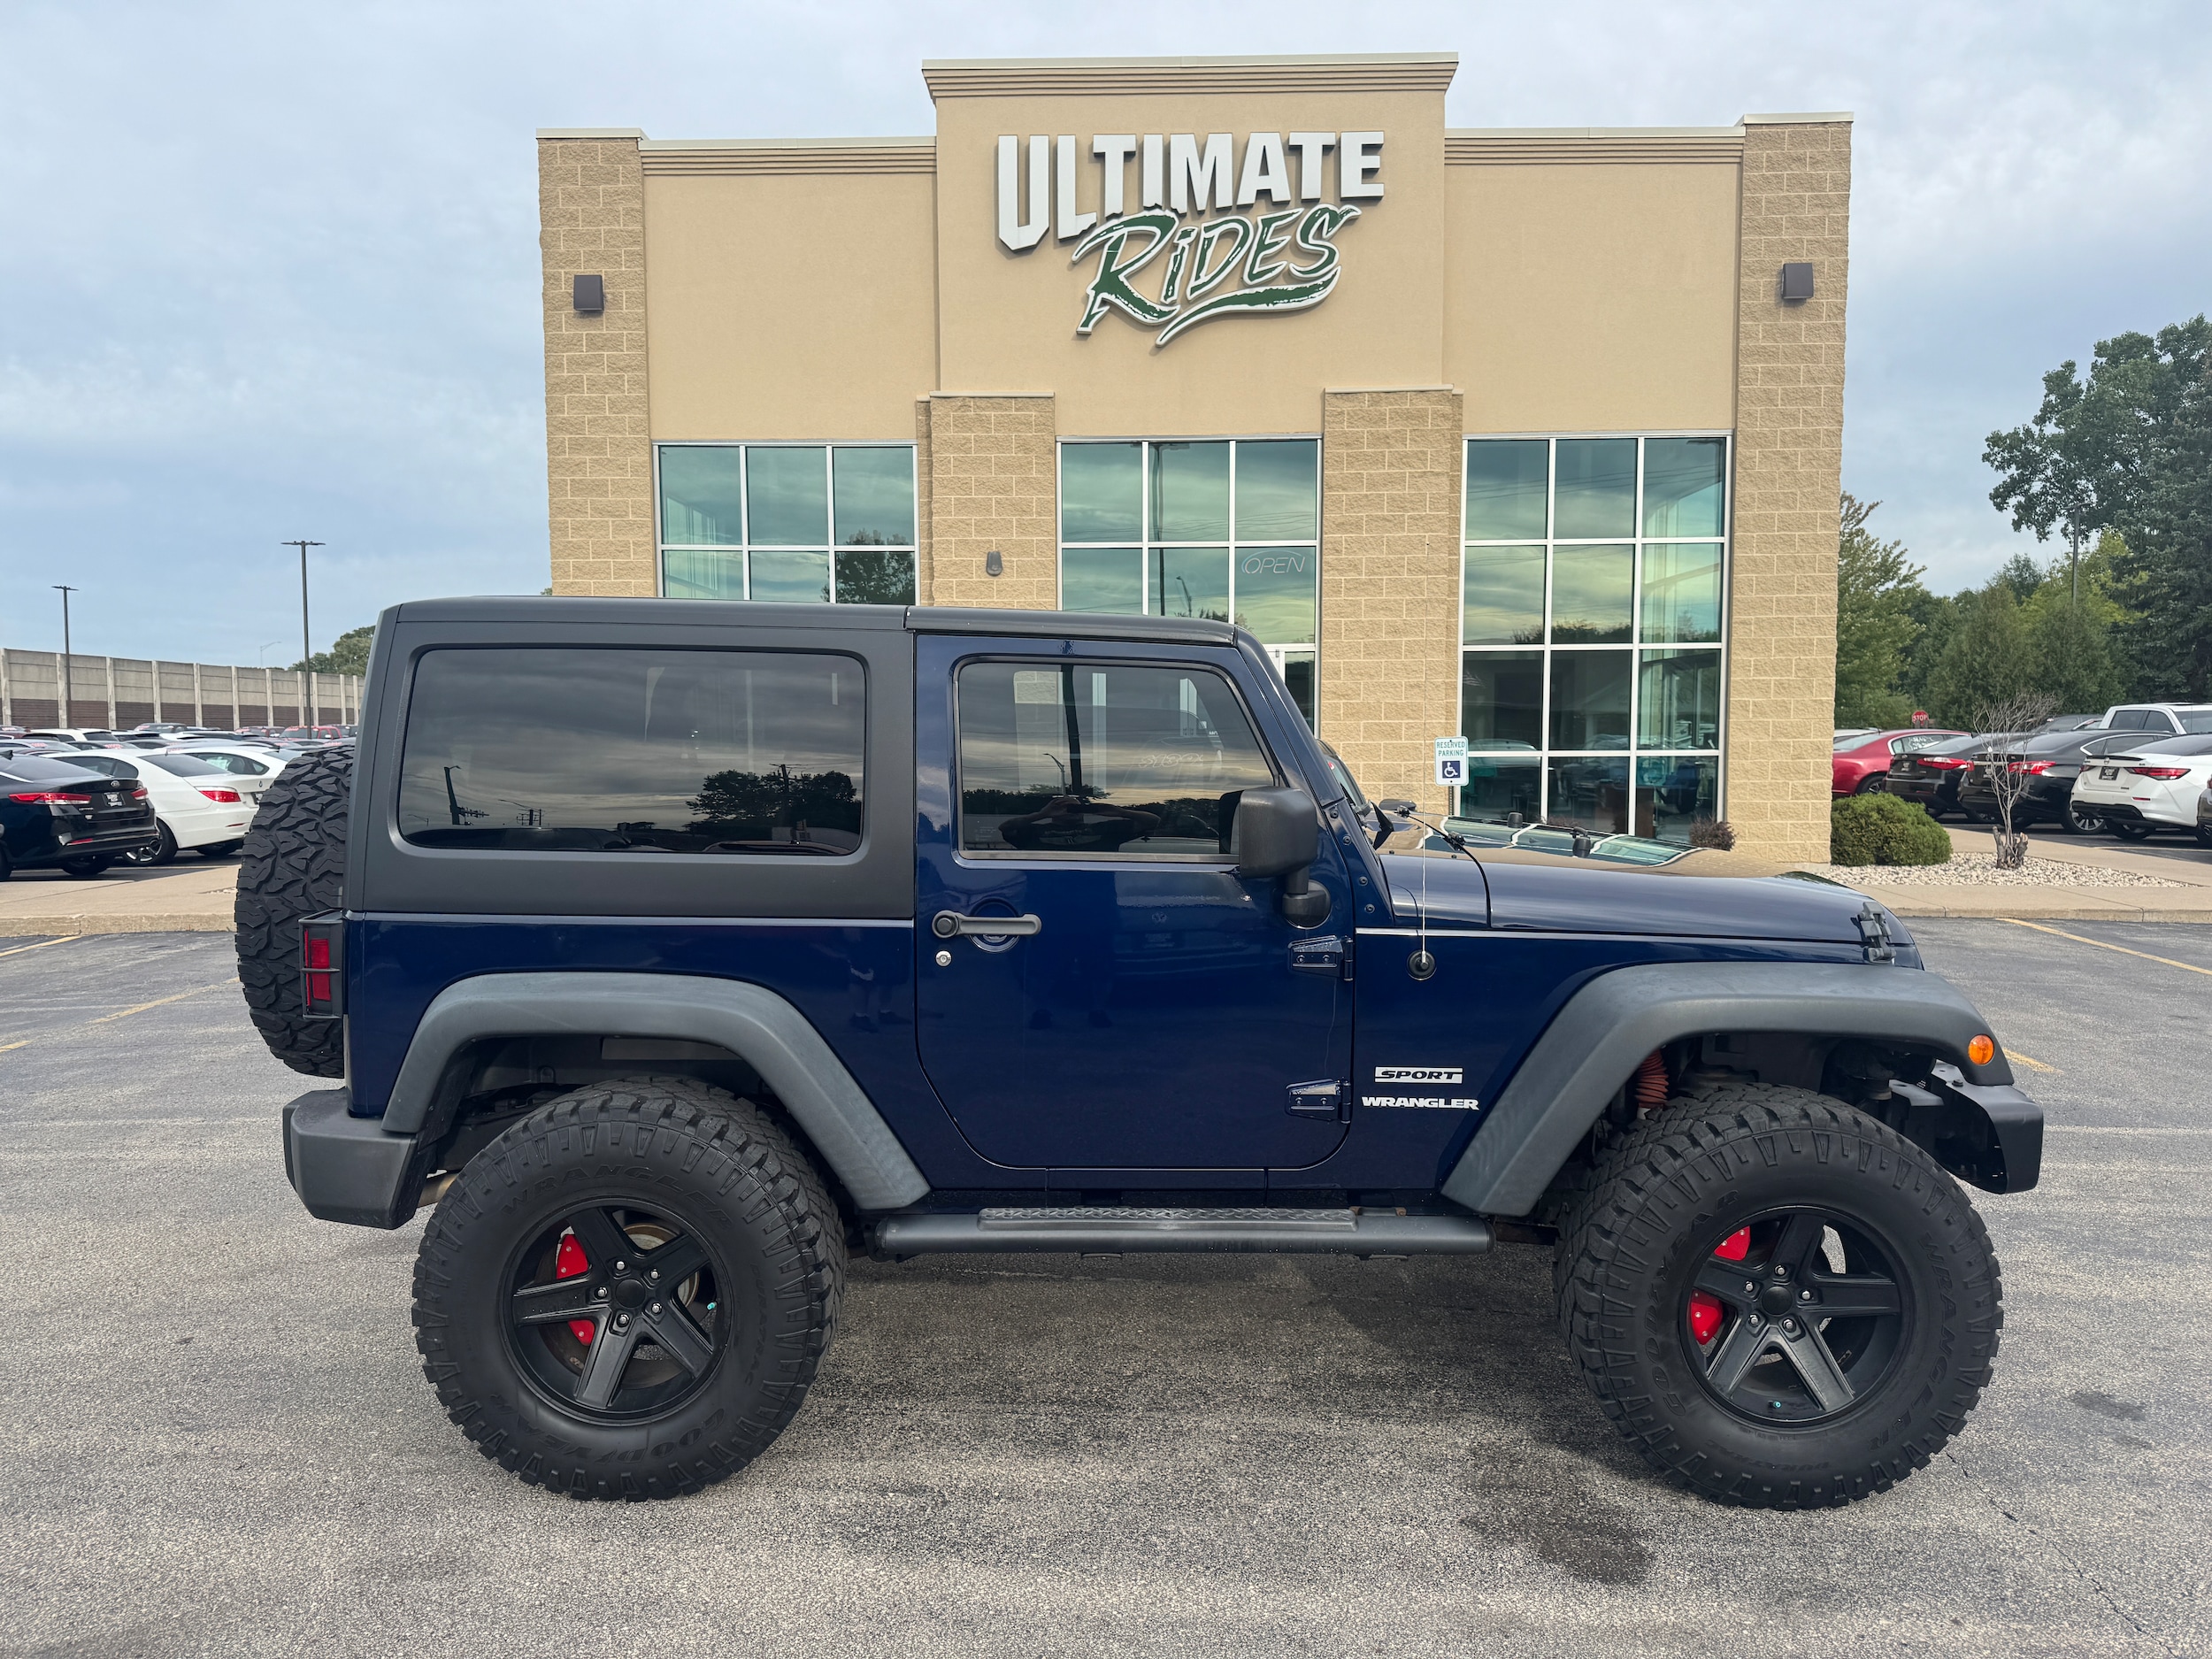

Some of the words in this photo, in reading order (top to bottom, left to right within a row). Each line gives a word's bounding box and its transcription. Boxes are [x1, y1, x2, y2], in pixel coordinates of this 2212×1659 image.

[997, 131, 1385, 253] ULTIMATE
[1245, 557, 1305, 573] OPEN
[1362, 1096, 1479, 1110] WRANGLER
[1375, 1069, 1463, 1080] SPORT
[499, 1164, 733, 1230] WRANGLER
[1644, 1189, 1740, 1417] GOODYEAR
[1869, 1232, 1957, 1453] WRANGLER
[488, 1394, 726, 1465] GOODYEAR
